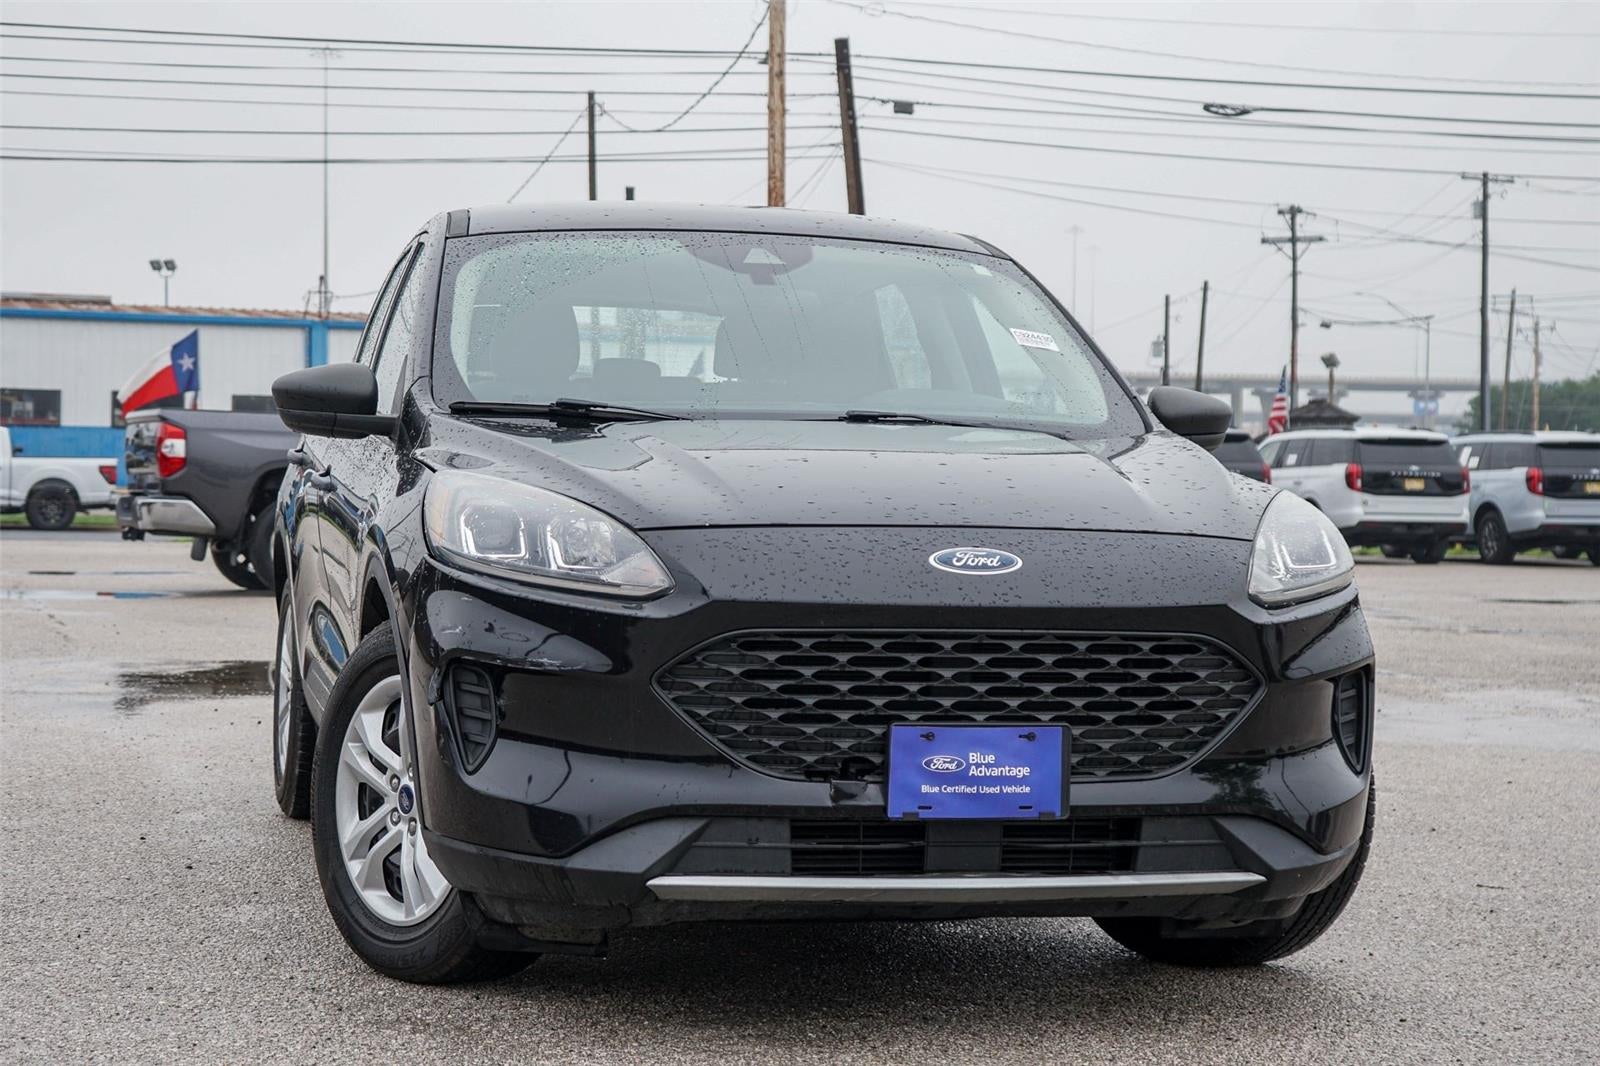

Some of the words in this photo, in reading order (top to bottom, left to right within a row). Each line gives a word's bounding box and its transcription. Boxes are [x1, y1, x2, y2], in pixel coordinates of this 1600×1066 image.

[952, 551, 1001, 567] Ford
[931, 757, 958, 770] Ford
[969, 752, 995, 764] Blue
[969, 765, 1030, 778] Advantage
[921, 784, 940, 793] Blue
[941, 784, 977, 794] Certified
[979, 785, 1000, 794] Used
[1002, 785, 1031, 793] Vehicle
